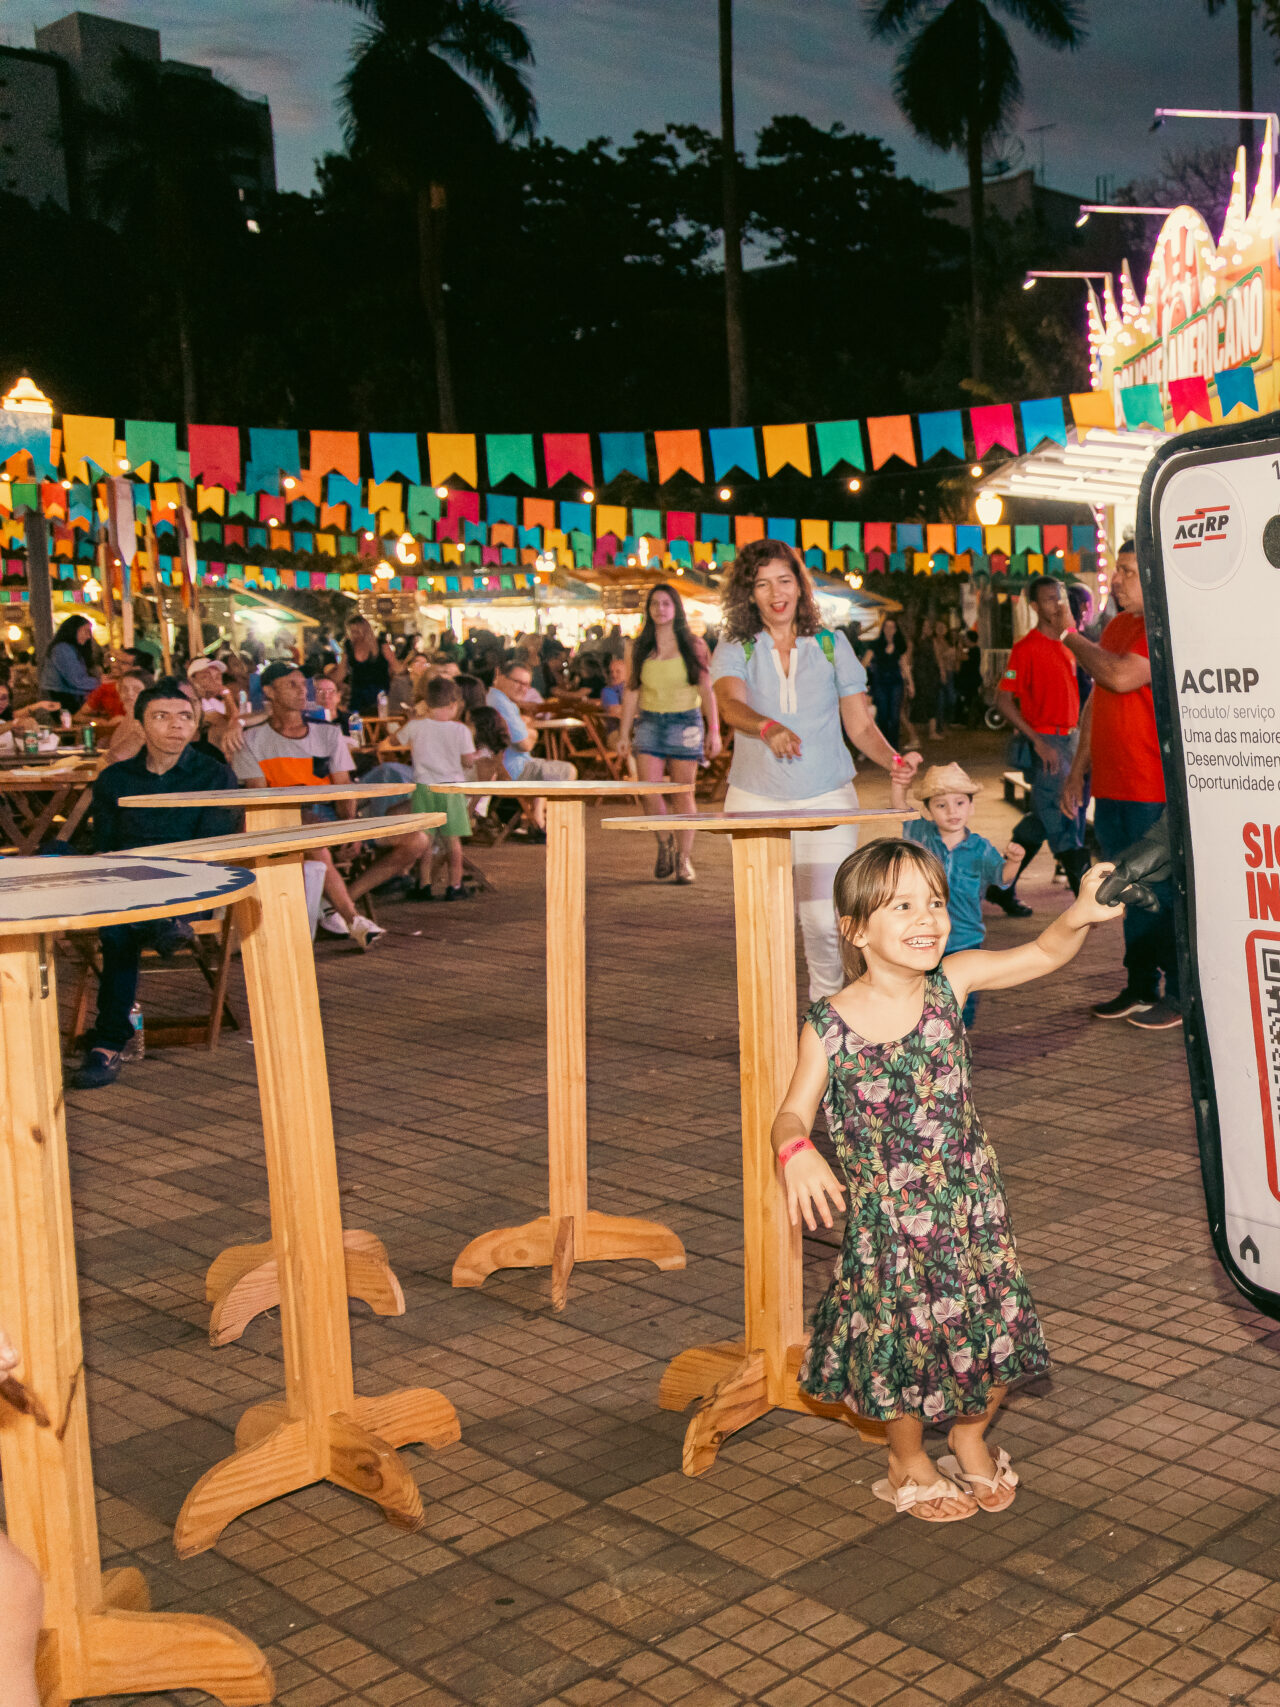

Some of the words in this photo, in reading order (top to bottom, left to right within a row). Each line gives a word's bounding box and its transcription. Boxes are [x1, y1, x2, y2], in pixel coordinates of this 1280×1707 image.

[1167, 276, 1263, 396] AMERICANO
[1175, 515, 1229, 540] ACIRP
[1181, 668, 1259, 694] ACIRP
[1181, 705, 1230, 719] Produto/
[1233, 705, 1275, 722] serviço
[1184, 729, 1212, 743] Uma
[1214, 728, 1237, 743] das
[1188, 774, 1275, 792] Oportunidade
